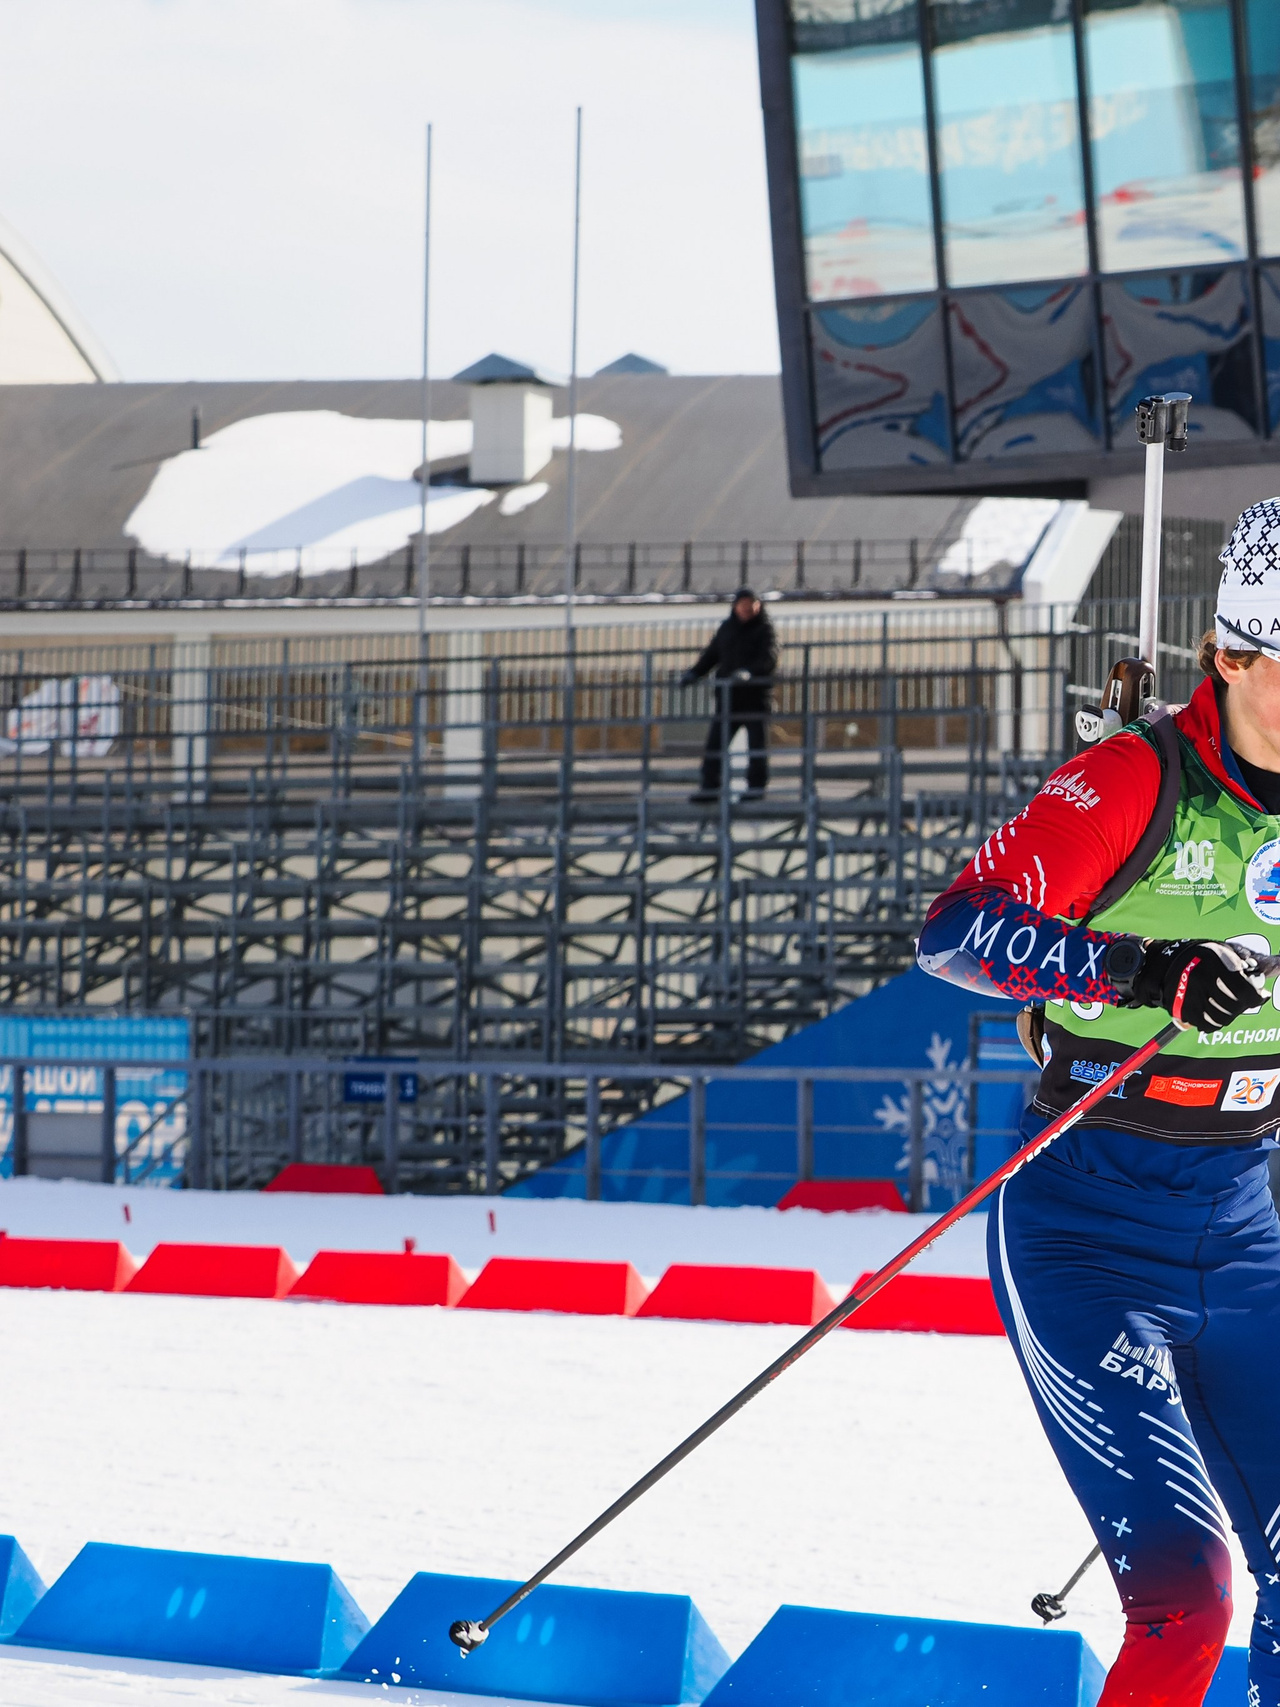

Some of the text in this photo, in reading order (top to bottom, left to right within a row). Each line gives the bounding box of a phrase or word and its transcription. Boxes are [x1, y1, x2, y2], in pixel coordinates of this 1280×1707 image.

[1037, 785, 1089, 814] АРУС
[1156, 888, 1194, 896] РОССИЙСКОЙ
[959, 911, 1106, 979] MOAX
[1176, 961, 1195, 1000] MOAX
[1171, 1084, 1188, 1093] КРАЙ
[1172, 1079, 1219, 1090] КРАСНОЯРСКИЙ
